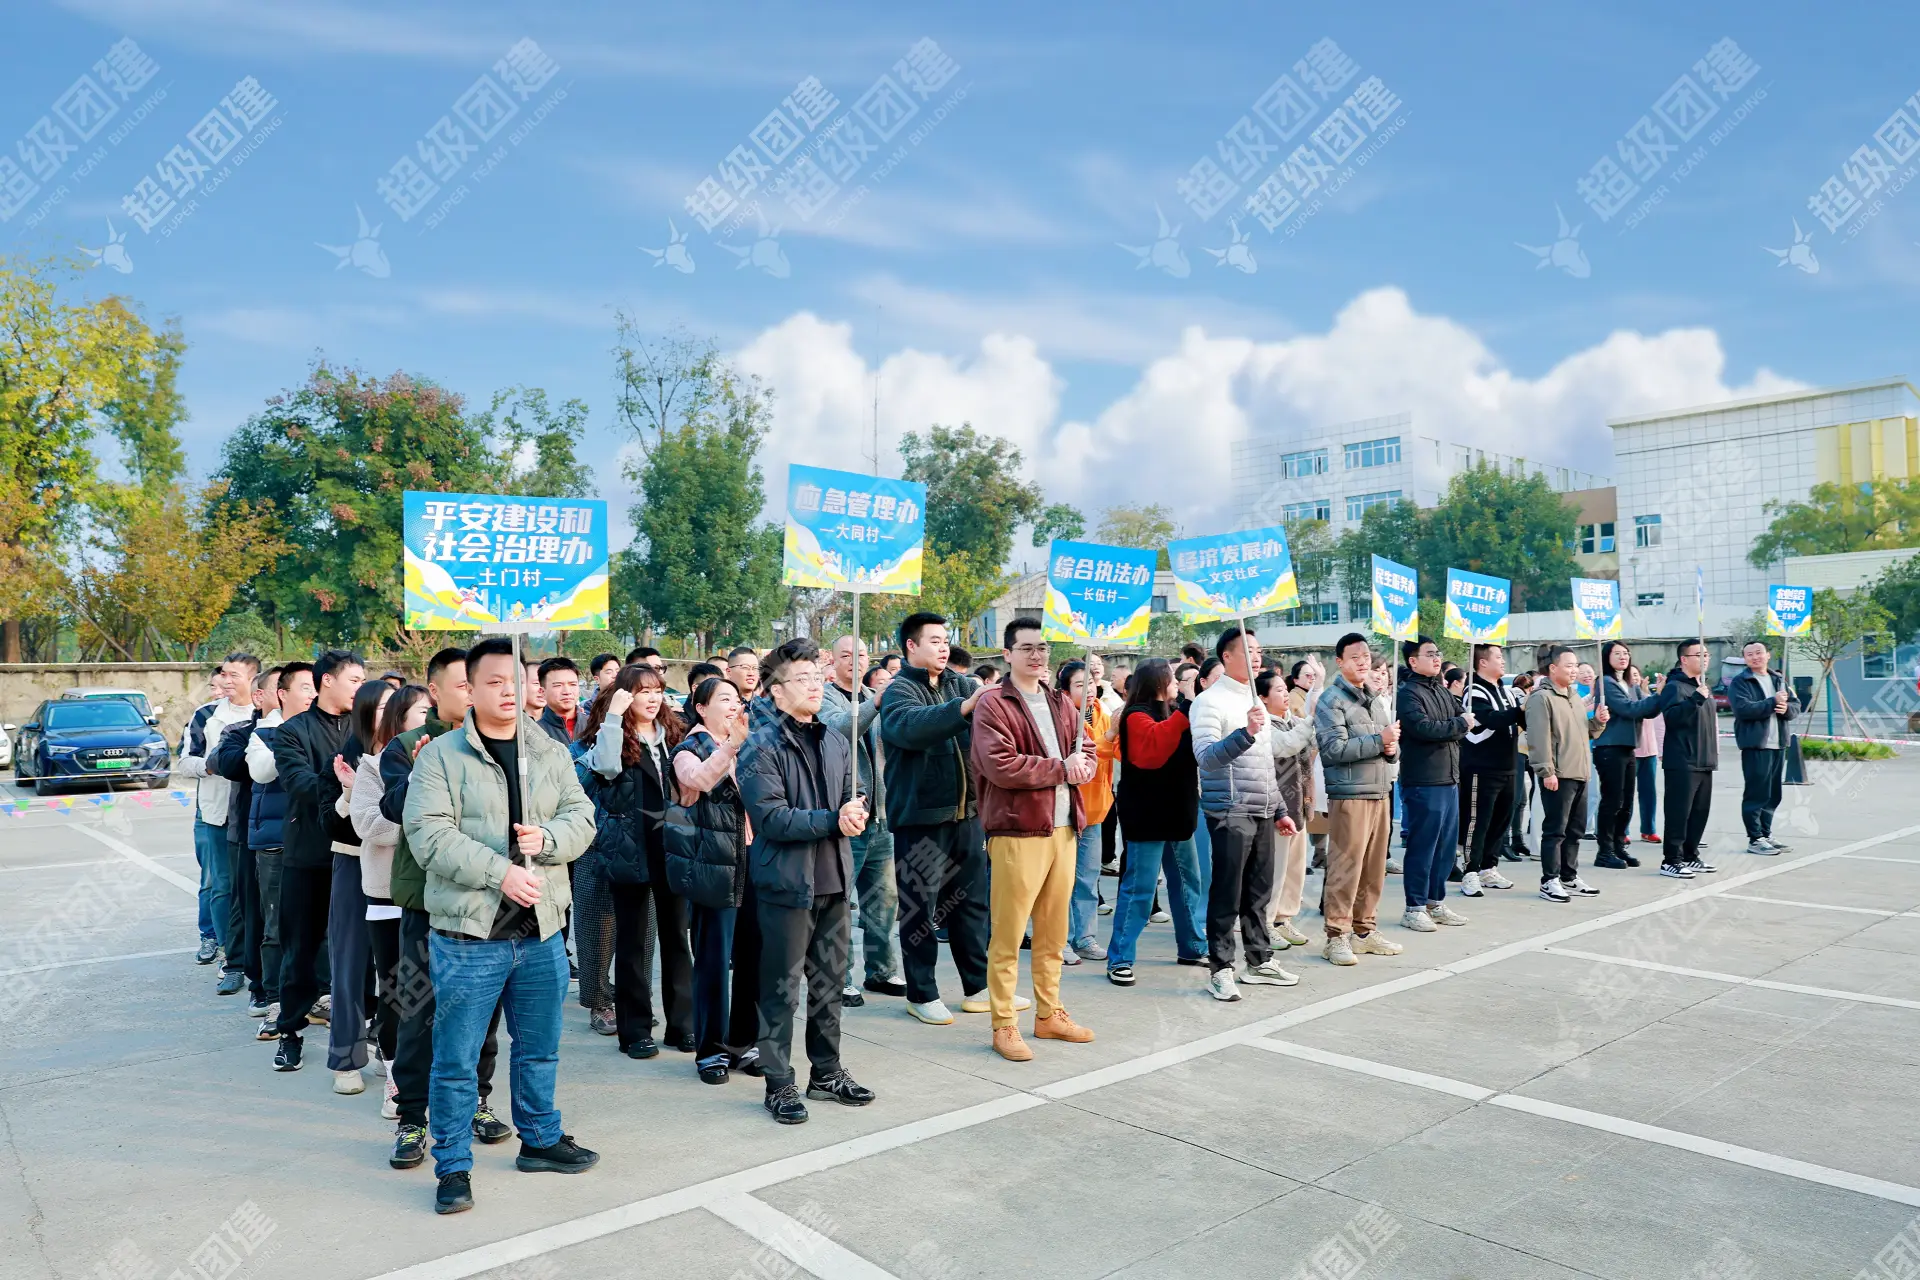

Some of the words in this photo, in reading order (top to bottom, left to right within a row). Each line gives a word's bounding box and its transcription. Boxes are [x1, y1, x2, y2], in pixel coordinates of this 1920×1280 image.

[422, 501, 593, 534] 平安建设和
[794, 484, 920, 524] 应急管理办
[836, 524, 880, 543] 大同村
[423, 532, 593, 565] 社会治理办
[1178, 539, 1282, 572] 经济发展办
[478, 567, 542, 587] 土门村
[1054, 556, 1150, 586] 综合执法办
[1210, 566, 1260, 584] 文安社区
[1376, 568, 1416, 595] 民生服务办
[1084, 587, 1118, 603] 长伍村
[1451, 580, 1506, 604] 党建工作办
